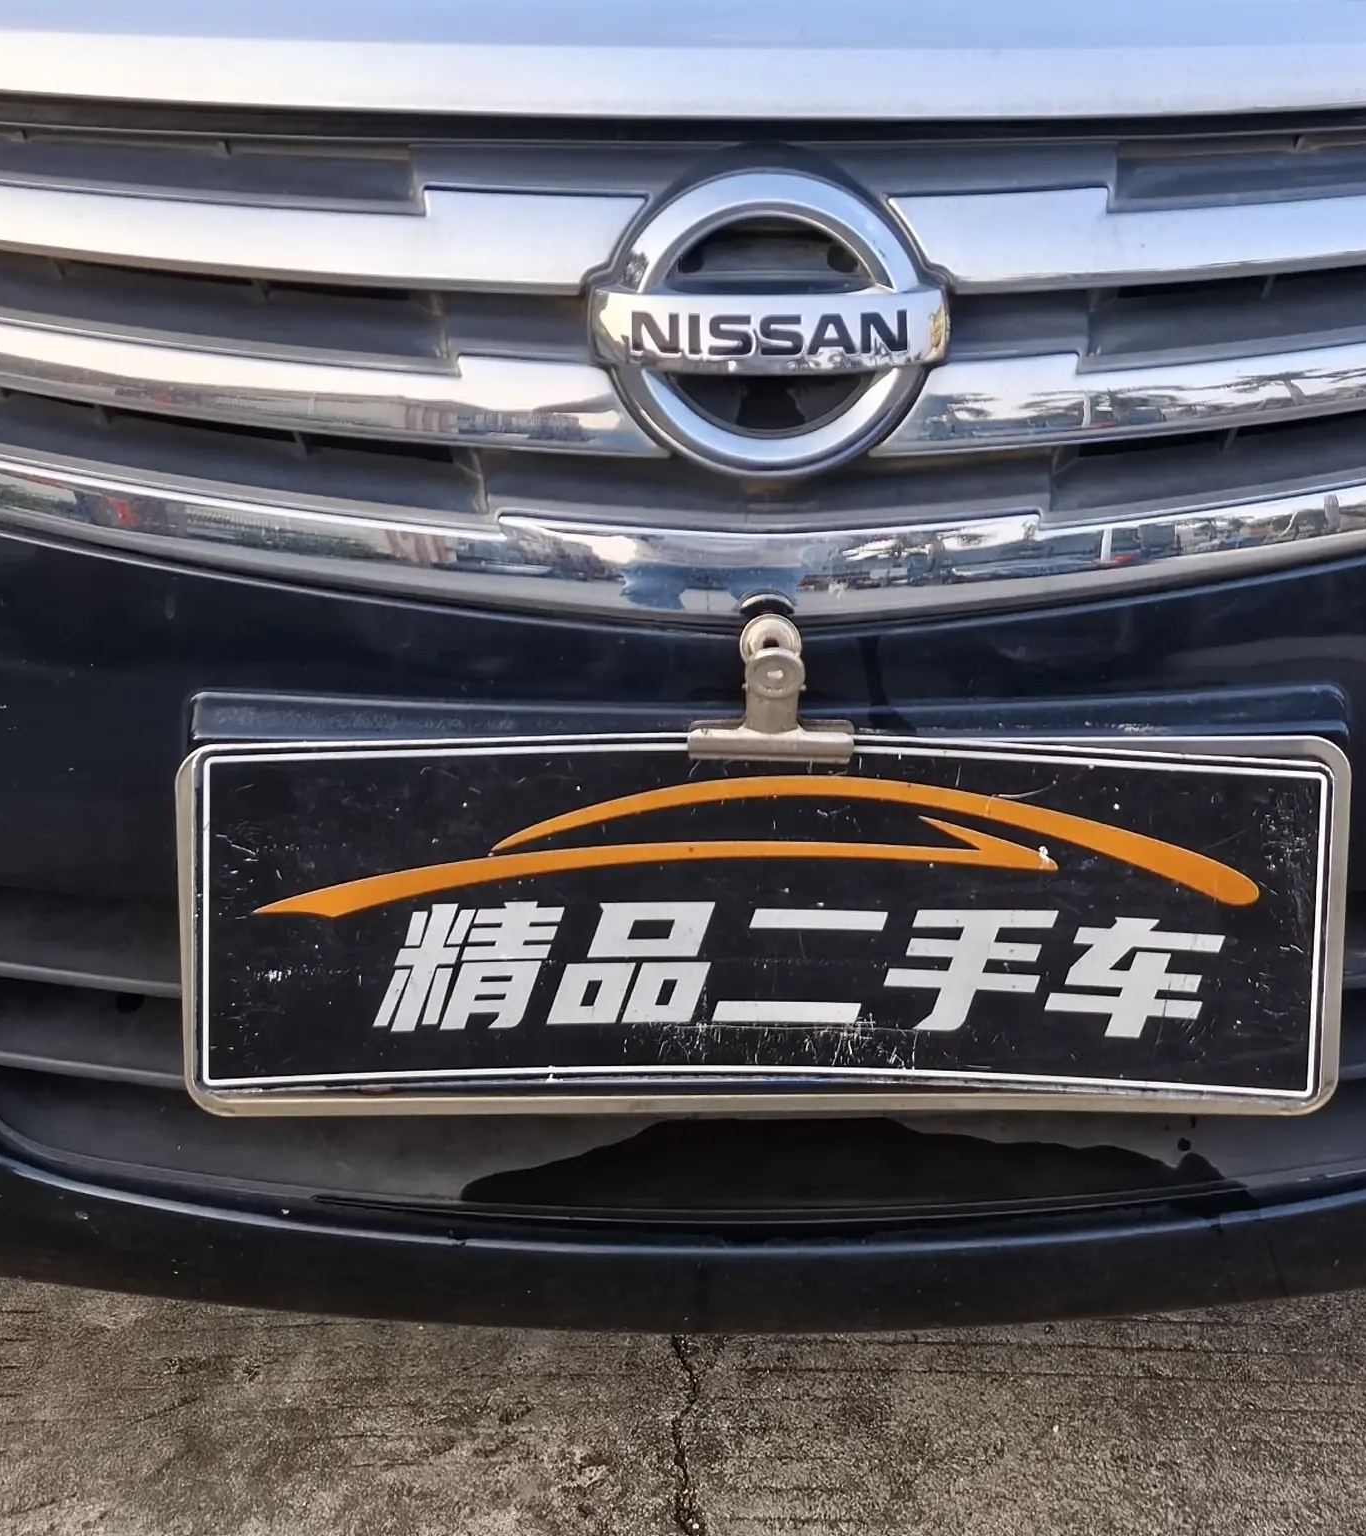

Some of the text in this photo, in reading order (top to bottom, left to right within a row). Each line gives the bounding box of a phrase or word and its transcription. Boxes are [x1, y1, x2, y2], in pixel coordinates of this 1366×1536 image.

[630, 309, 909, 357] NISSAN
[372, 900, 1225, 1039] 精品二手车
